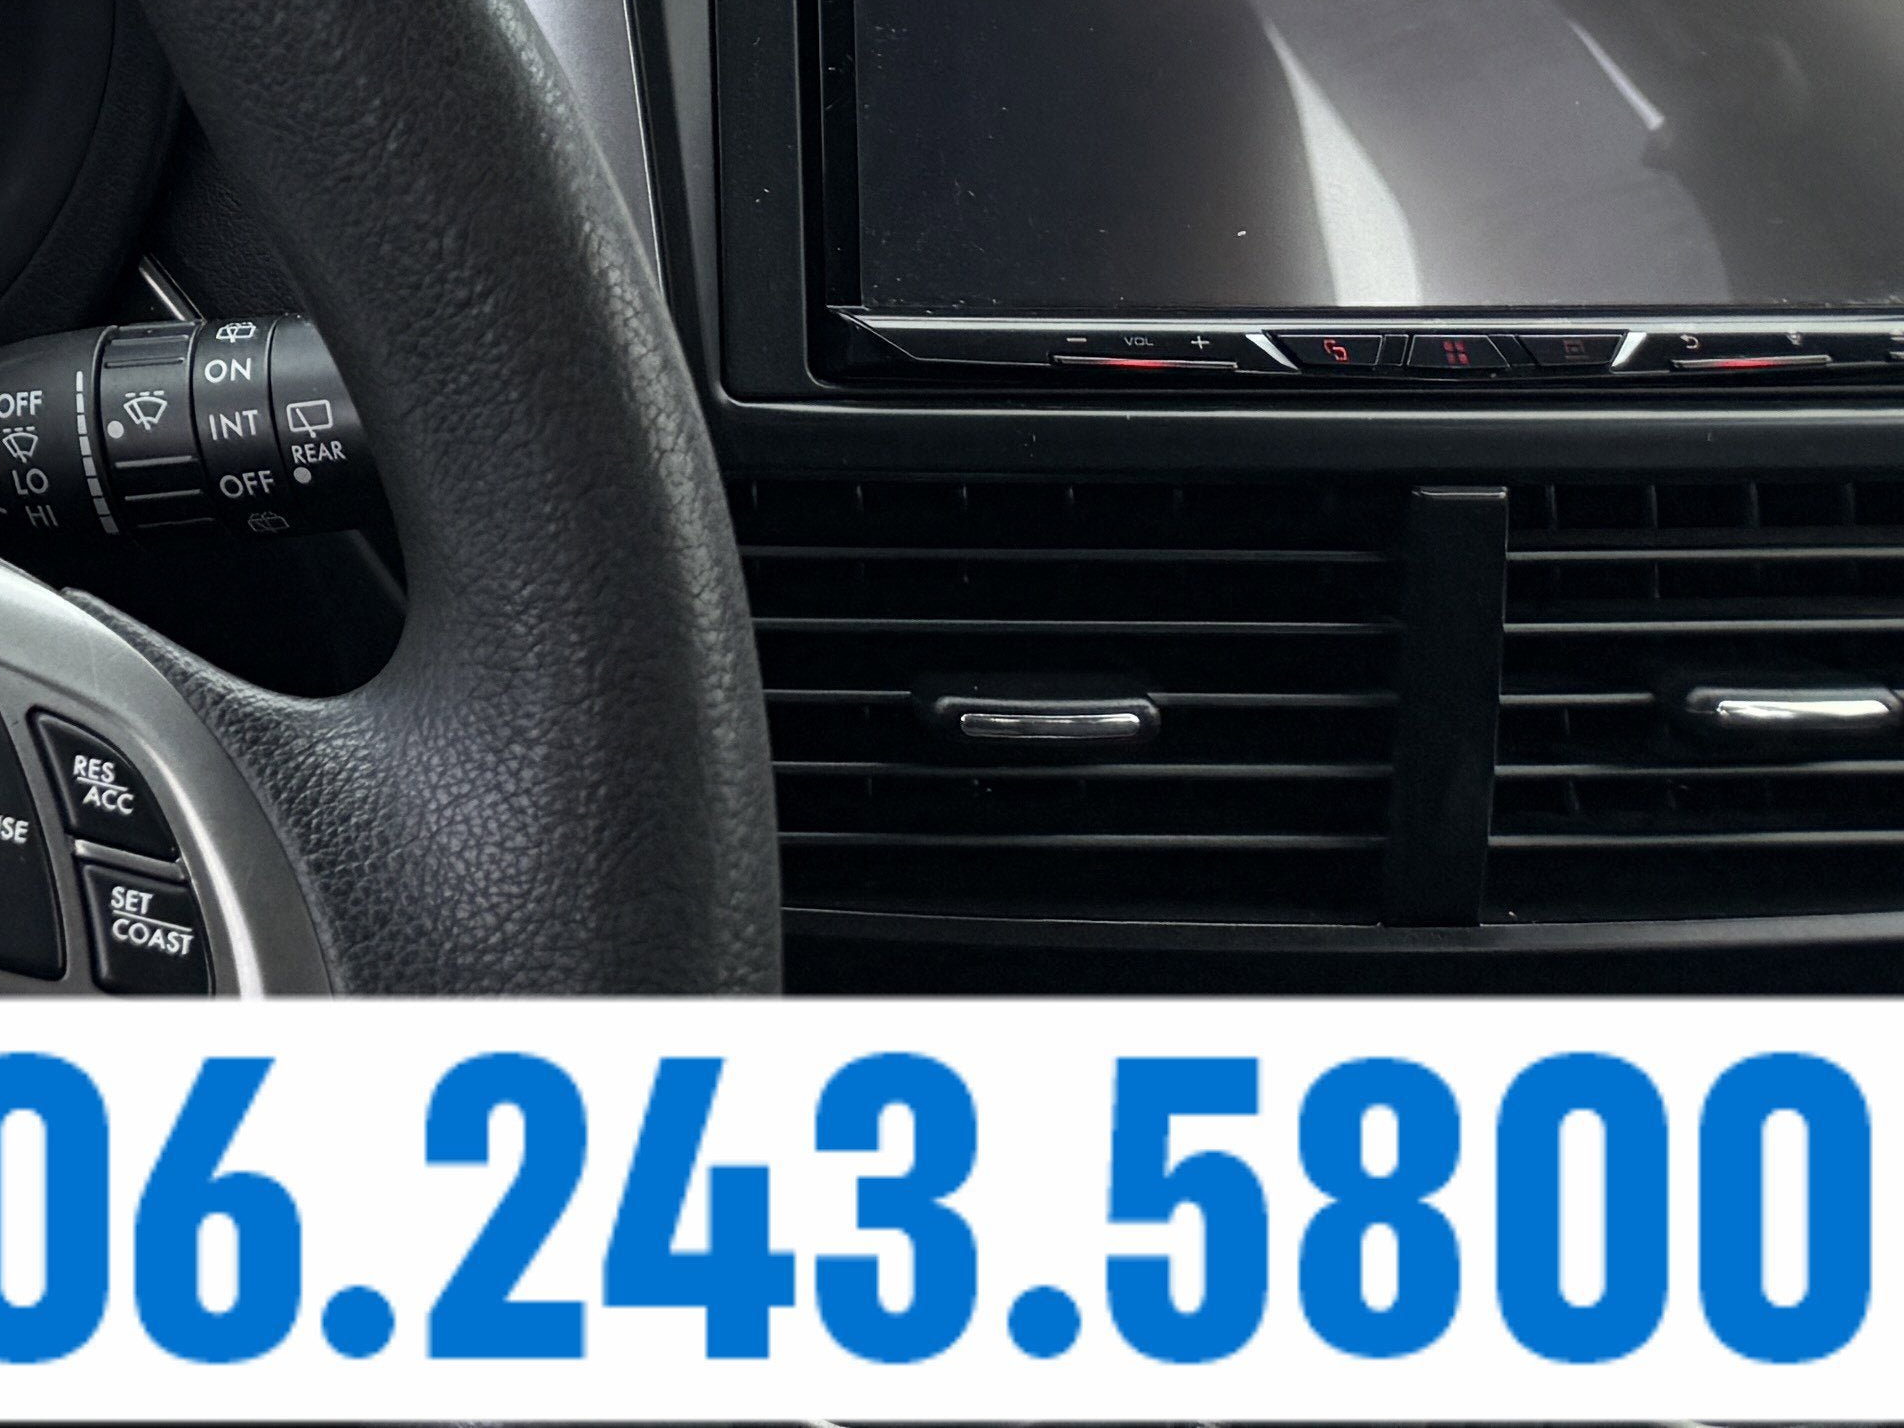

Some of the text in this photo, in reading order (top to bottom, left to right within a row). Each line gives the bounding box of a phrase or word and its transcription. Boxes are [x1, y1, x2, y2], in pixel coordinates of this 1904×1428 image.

[1123, 334, 1154, 347] VOL
[205, 358, 251, 383] ON
[209, 410, 258, 440] INT
[292, 441, 345, 463] REAR
[12, 468, 48, 494] LO
[220, 470, 273, 497] OFF
[25, 505, 58, 526] HI
[74, 755, 114, 778] RES
[83, 786, 133, 814] ACC
[111, 886, 153, 915] SET
[112, 917, 193, 955] COAST
